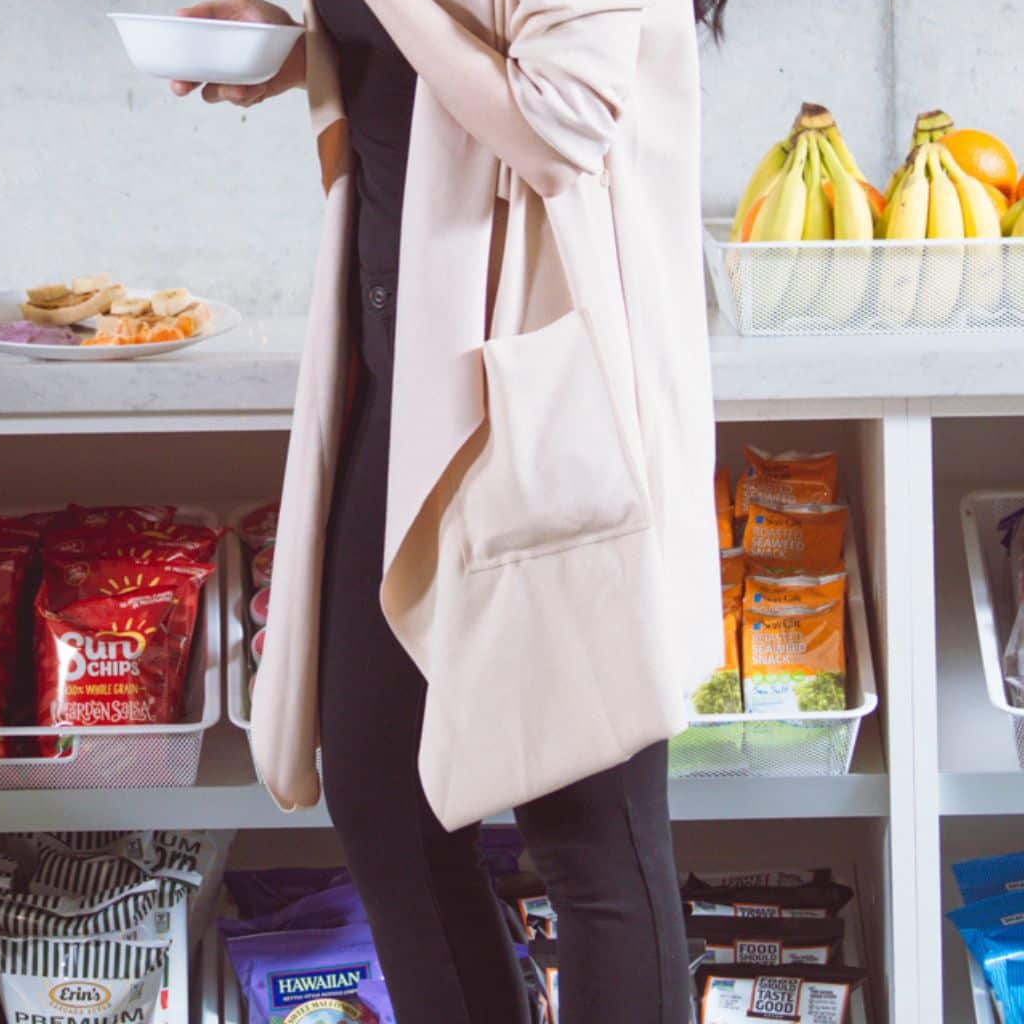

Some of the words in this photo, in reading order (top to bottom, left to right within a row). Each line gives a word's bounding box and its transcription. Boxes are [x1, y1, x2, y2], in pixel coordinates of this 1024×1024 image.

[58, 631, 147, 682] Sun
[752, 655, 791, 665] SNACK
[86, 661, 141, 678] CHIPS
[85, 684, 113, 696] WHOLE
[114, 683, 139, 696] GRAIN
[739, 943, 777, 954] FOOD
[738, 954, 777, 962] SHOULD
[278, 971, 361, 995] HAWAIIAN
[759, 983, 797, 992] SHOULD
[58, 986, 102, 1002] Erin's
[758, 989, 795, 1002] TASTE
[755, 1000, 794, 1014] GOOD
